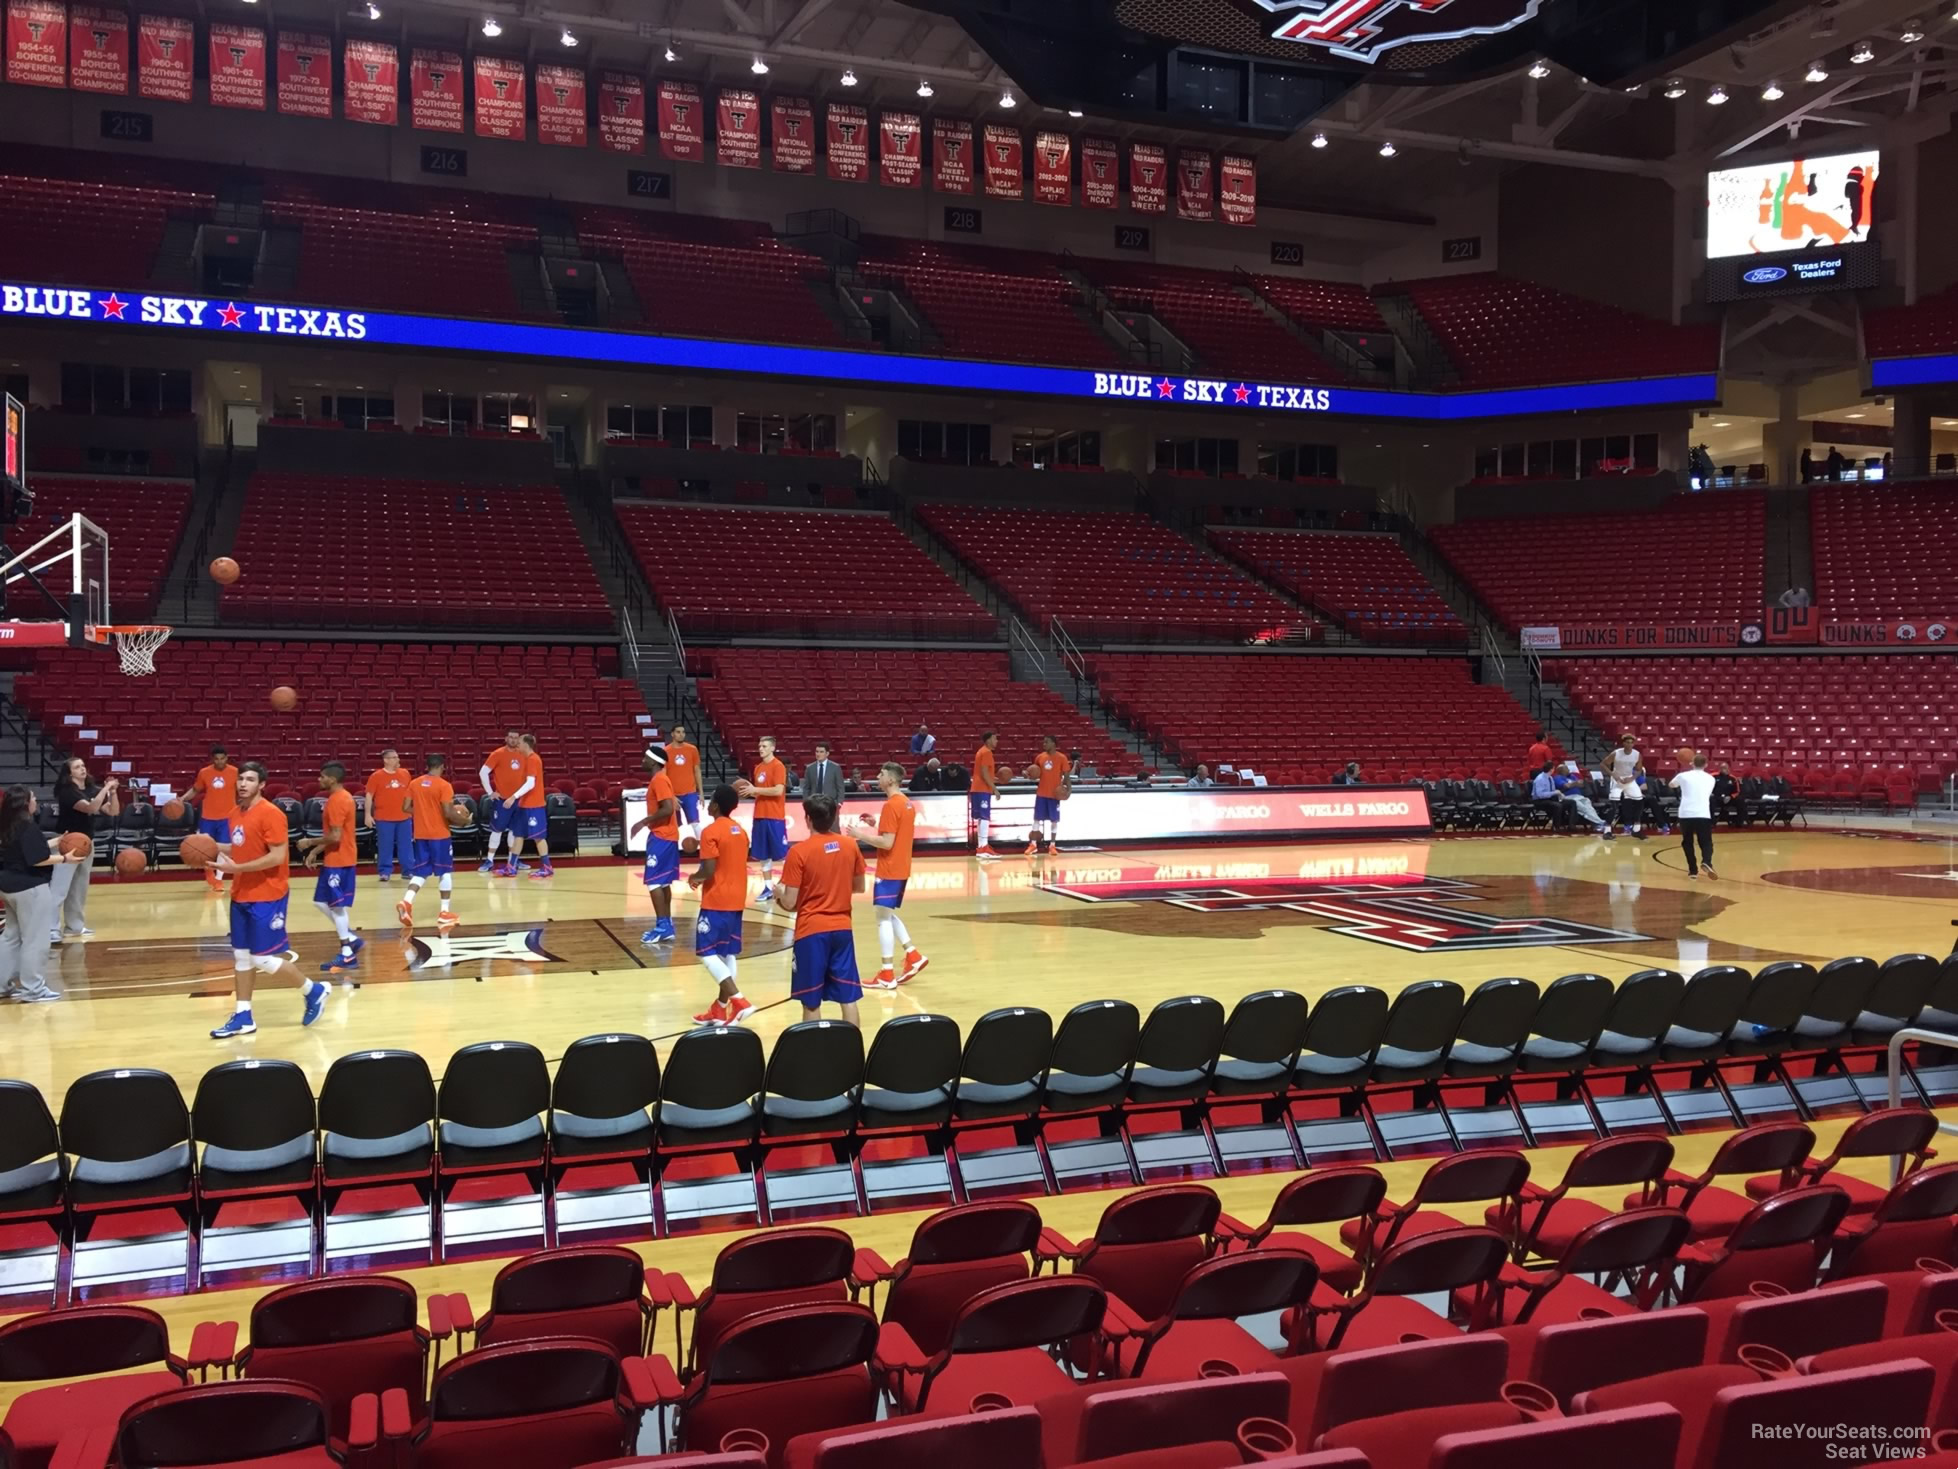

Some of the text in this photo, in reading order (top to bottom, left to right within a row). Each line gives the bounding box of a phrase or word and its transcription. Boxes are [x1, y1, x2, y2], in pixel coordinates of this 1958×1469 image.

[212, 36, 262, 48] RED RAIDERS
[16, 52, 56, 63] BORDER
[477, 57, 502, 68] TEXAS
[9, 61, 64, 74] CONFERENCE
[80, 60, 120, 70] BORDER
[72, 68, 127, 80] CONFERENCE
[477, 67, 523, 80] RED RAIDERS
[74, 79, 124, 91] CHAMPIONS
[140, 76, 191, 90] CONFERENCE
[212, 75, 262, 87] SOUTHWEST
[211, 84, 262, 96] CONFERENCE
[279, 82, 329, 95] SOUTHWEST
[348, 81, 394, 93] CHAMPIONS
[279, 92, 330, 105] CONFERENCE
[661, 92, 699, 103] RED RAIDERS
[281, 103, 329, 115] CHAMPIONS
[352, 100, 385, 111] CLASSIC
[414, 98, 461, 110] SOUTHWEST
[478, 98, 522, 109] CHAMPIONS
[829, 103, 849, 114] TEXAS
[414, 108, 461, 120] CONFERENCE
[540, 106, 583, 116] CHAMPIONS
[415, 118, 460, 129] CHAMPIONS
[480, 116, 512, 126] CLASSIC
[601, 115, 643, 127] CHAMPIONS
[828, 115, 867, 125] RED RAIDERS
[112, 117, 142, 135] 215
[541, 124, 573, 133] CLASSIC
[670, 124, 691, 133] NCAA
[604, 134, 639, 145] CLASSIC
[660, 132, 702, 144] EAST REGIONAL
[720, 130, 757, 140] CHAMPIONS
[721, 139, 757, 149] SOUTHWEST
[779, 138, 808, 148] NATIONAL
[830, 142, 865, 151] SOUTHWEST
[719, 148, 758, 159] CONFERENCE
[777, 146, 811, 156] INVITATION
[829, 149, 866, 158] CONFERENCE
[1134, 144, 1150, 154] TEXAS
[430, 152, 458, 170] 216
[776, 156, 812, 165] TOURNAMENT
[830, 156, 865, 166] CHAMPIONS
[885, 154, 918, 162] CHAMPIONS
[1225, 156, 1252, 168] TEXAS TECH
[882, 160, 920, 169] POST-SEASON
[938, 173, 969, 182] SIXTEEN
[1233, 168, 1252, 176] RAIDERS
[637, 176, 662, 192] 217
[986, 187, 1022, 196] TOURNAMENT
[1048, 186, 1065, 194] PLACE
[1090, 196, 1110, 204] NCAA
[1222, 191, 1254, 202] 2009-2010
[1132, 201, 1156, 210] SWEET
[951, 212, 975, 228] 218
[1122, 231, 1143, 246] 219
[1275, 247, 1300, 262] 220
[1450, 243, 1472, 257] 221
[1792, 259, 1842, 271] Texas Ford
[1752, 269, 1778, 280] Ford
[1800, 268, 1835, 279] Dealers
[2, 284, 367, 340] BLUE SKY TEXAS
[1094, 373, 1330, 410] BLUE SKY TEXAS
[1563, 626, 1736, 645] DUNKS FOR DONUTS
[1824, 624, 1887, 643] DUNKS
[1298, 802, 1409, 817] WELLS FARGO
